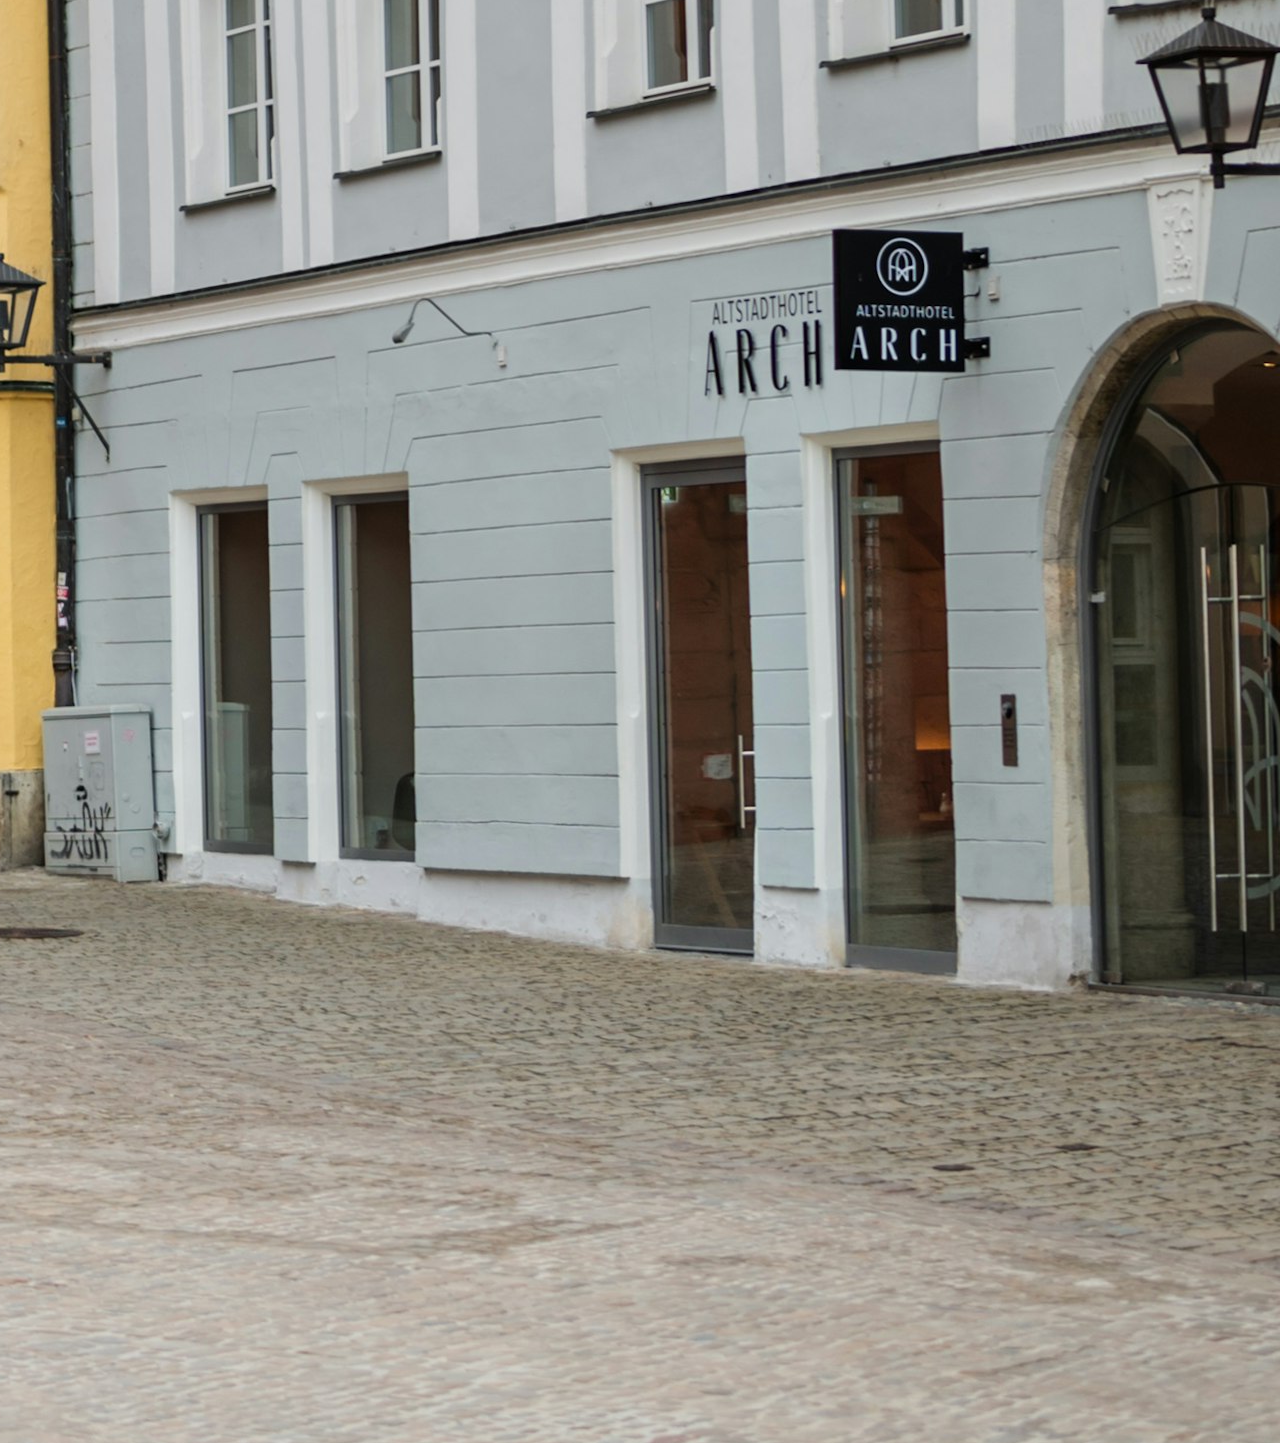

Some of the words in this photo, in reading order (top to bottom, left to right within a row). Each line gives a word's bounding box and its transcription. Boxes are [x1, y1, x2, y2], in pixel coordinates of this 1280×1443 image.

[712, 290, 823, 325] ALTSTADTHOTEL
[856, 304, 956, 320] ALTSTADTHOTEL
[704, 319, 823, 396] ARCH
[850, 326, 957, 362] ARCH
